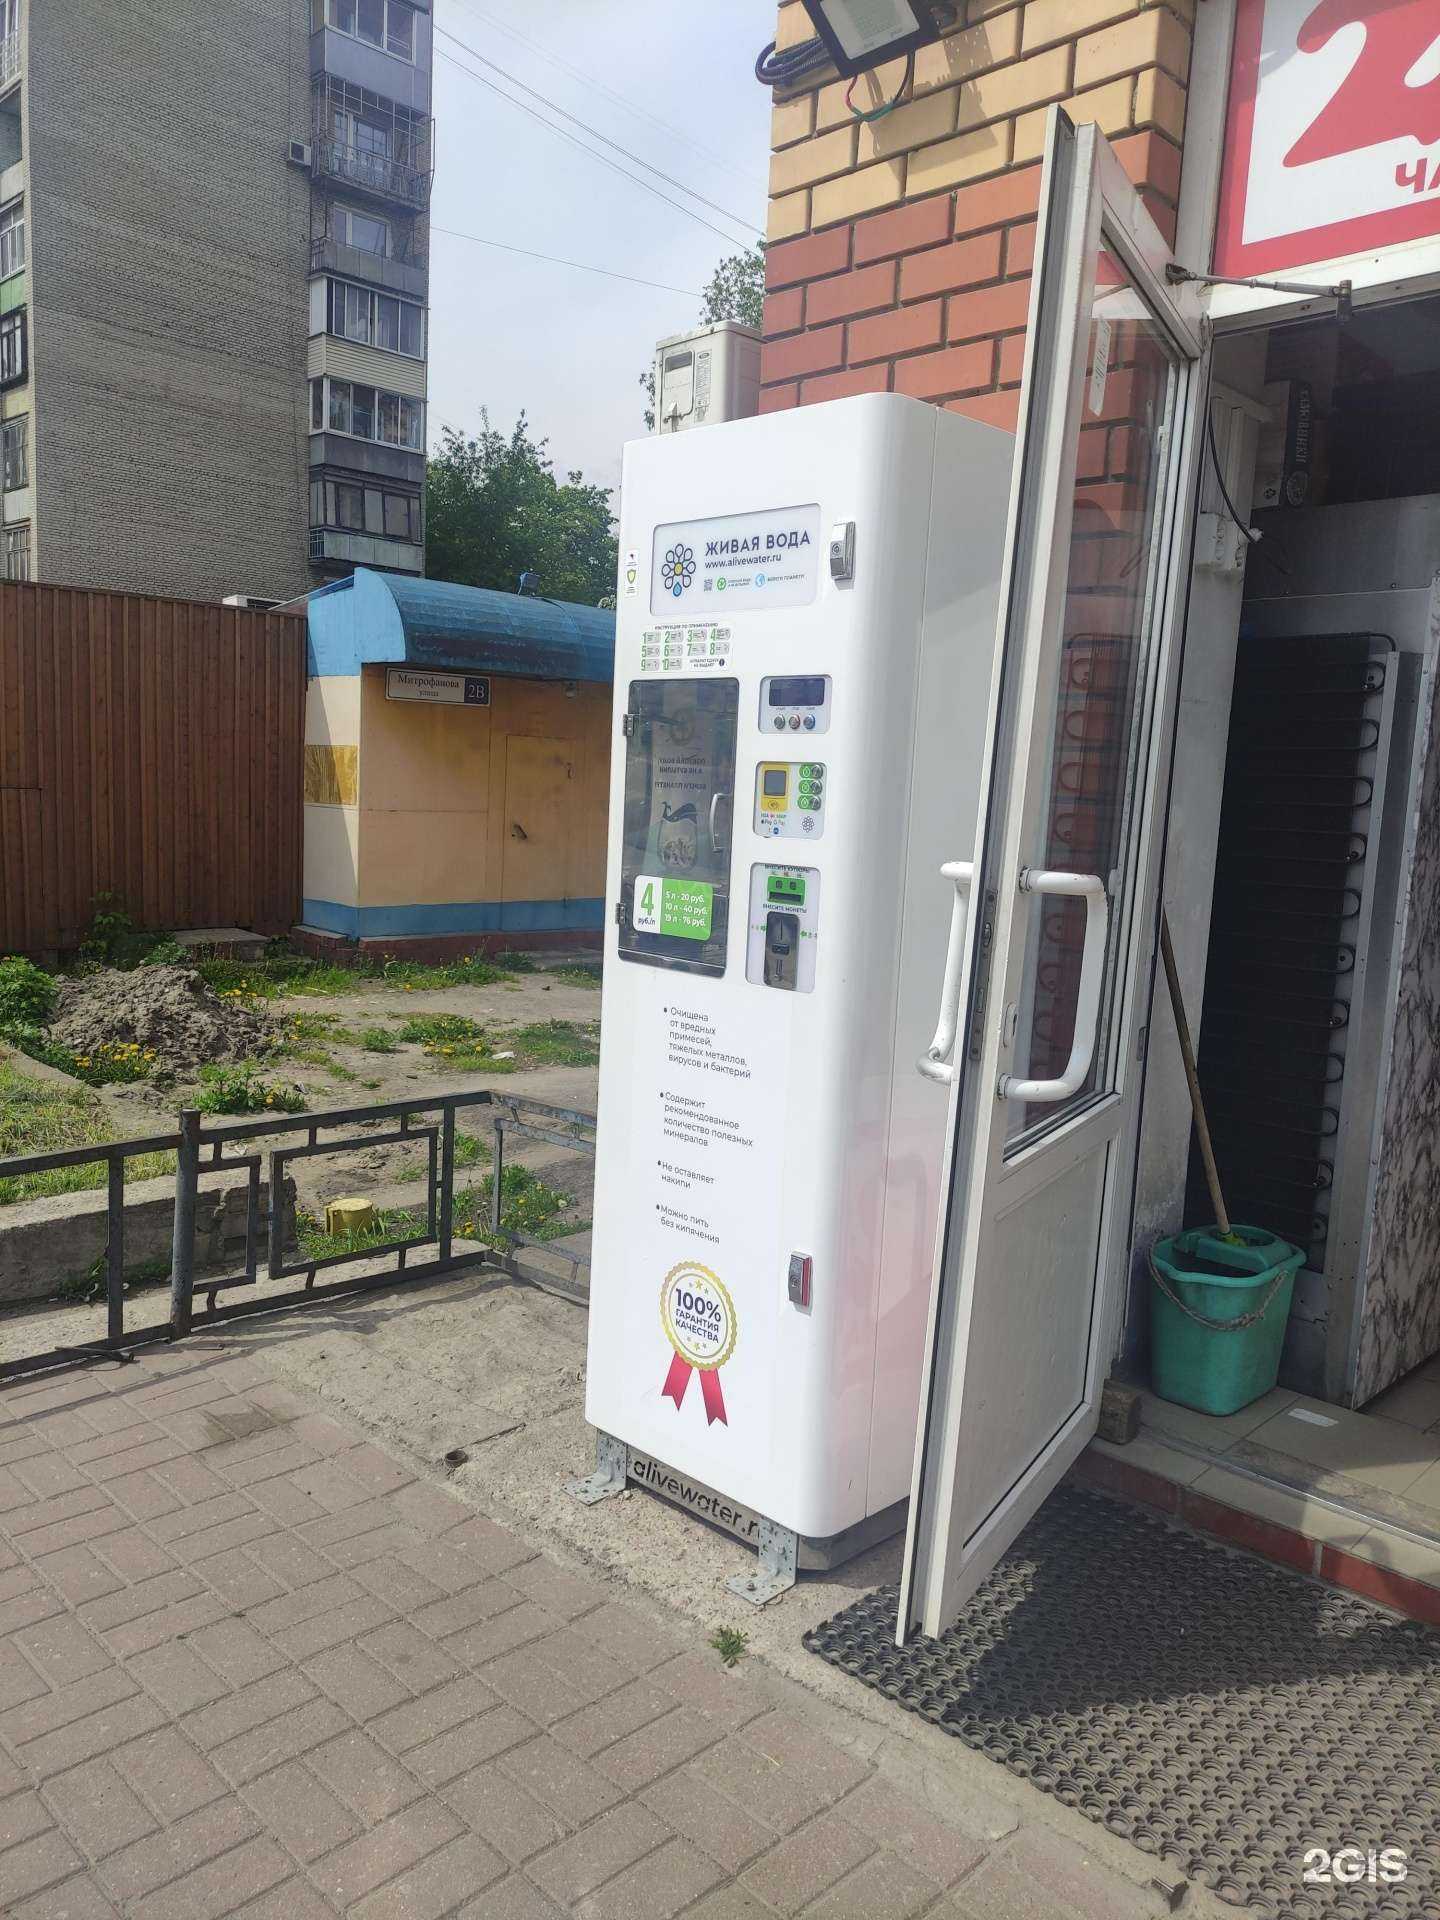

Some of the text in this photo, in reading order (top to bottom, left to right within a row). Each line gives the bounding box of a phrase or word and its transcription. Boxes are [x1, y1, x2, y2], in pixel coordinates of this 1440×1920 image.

[705, 530, 810, 556] ЖИВАЯ ВОДА
[704, 553, 782, 569] www.alivewater.ru
[664, 631, 670, 643] 2
[688, 630, 693, 642] 3
[710, 628, 716, 640] 4
[642, 646, 646, 657] 5
[664, 645, 670, 657] 6
[687, 644, 692, 656] 7
[710, 642, 715, 655] 8
[398, 674, 460, 688] Митрофанова
[641, 883, 654, 916] 4
[670, 1006, 708, 1022] Очищена
[670, 1020, 716, 1034] от вредных
[669, 1042, 704, 1056] тяжелых
[670, 1032, 712, 1048] примесей,
[668, 1054, 702, 1068] вирусов
[711, 1062, 751, 1079] бактерий
[665, 1092, 706, 1108] Содержит
[664, 1104, 740, 1130] рекомендованное
[664, 1117, 752, 1147] количество полезных
[664, 1128, 708, 1146] минералов
[662, 1162, 714, 1184] Не оставляет
[662, 1174, 690, 1188] накипи
[660, 1205, 709, 1228] Можно пить
[661, 1216, 720, 1244] без кипячения
[676, 1288, 721, 1322] 100%
[676, 1308, 719, 1332] ГАРАНТИЯ
[676, 1318, 719, 1344] КАЧЕСТВА
[633, 1460, 760, 1540] alivewater.r
